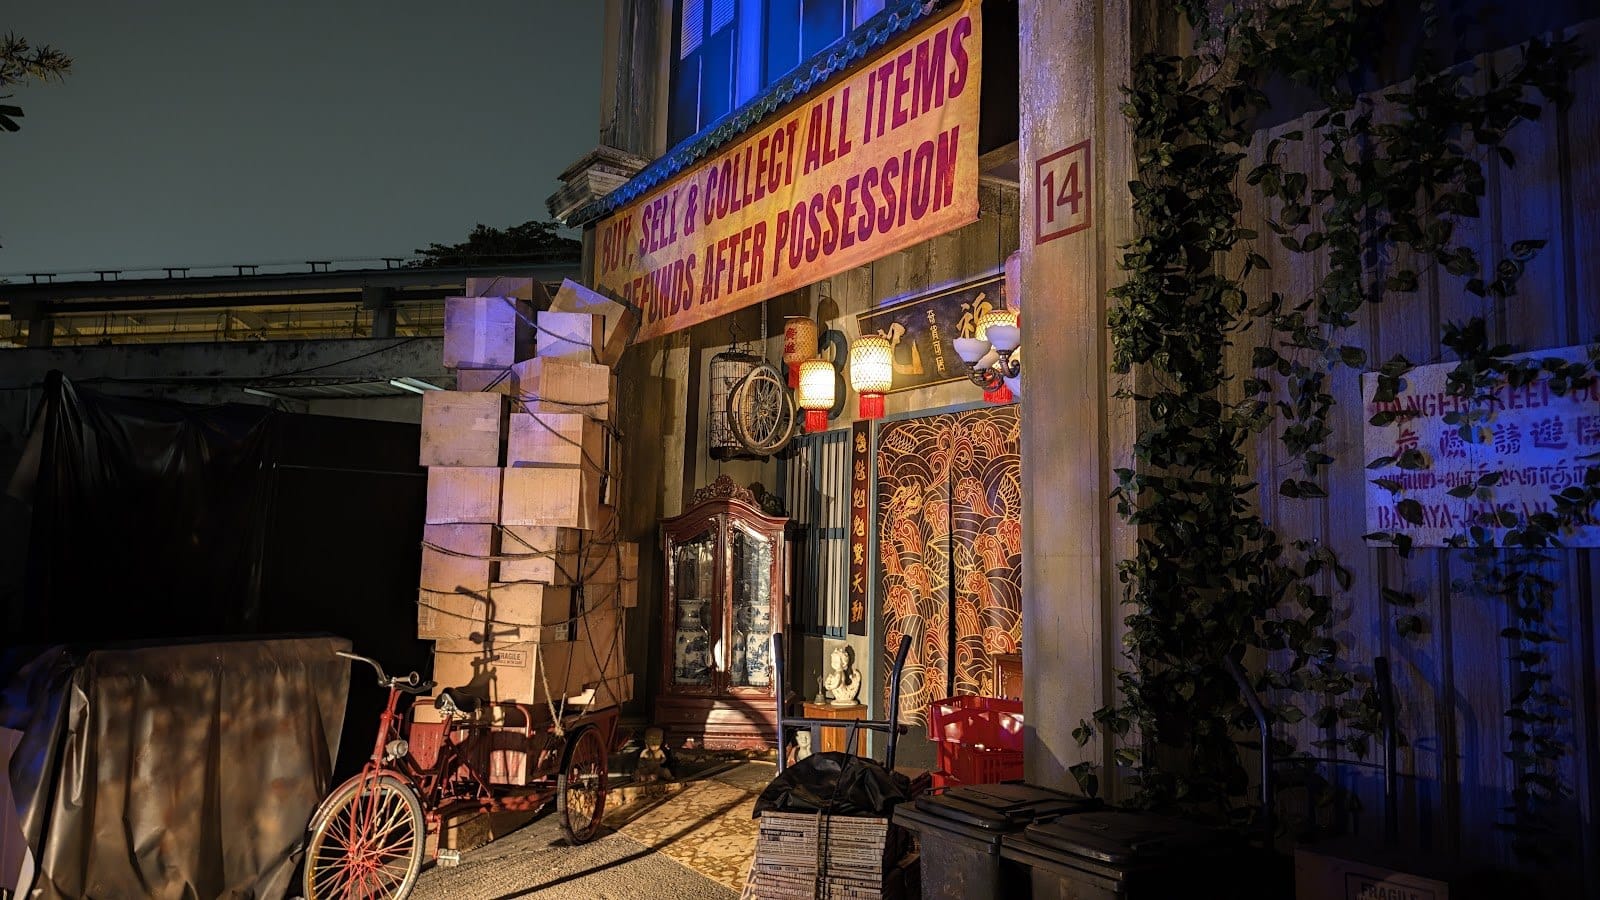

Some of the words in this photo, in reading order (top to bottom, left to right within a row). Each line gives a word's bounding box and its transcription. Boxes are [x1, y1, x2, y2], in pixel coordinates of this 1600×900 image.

[602, 215, 634, 277] BUY,
[640, 190, 678, 257] SELL
[683, 189, 698, 236] &
[704, 118, 798, 225] COLLECT
[804, 86, 852, 176] ALL
[863, 16, 972, 144] ITEMS
[699, 219, 767, 305] AFTER
[772, 126, 960, 278] POSSESSION
[1043, 161, 1083, 223] 14
